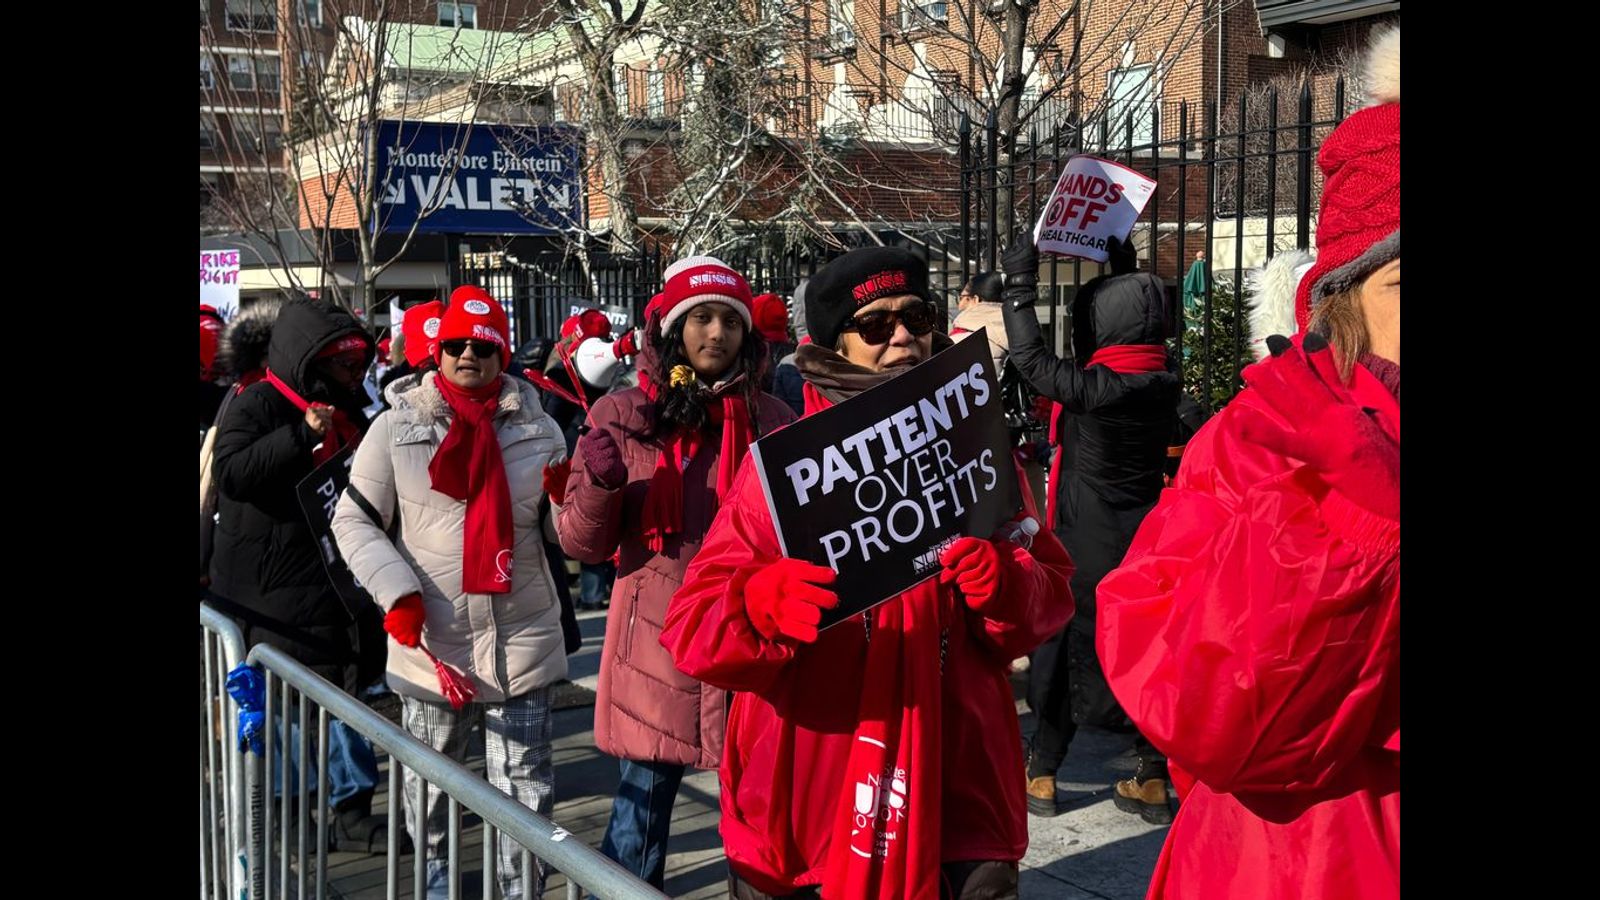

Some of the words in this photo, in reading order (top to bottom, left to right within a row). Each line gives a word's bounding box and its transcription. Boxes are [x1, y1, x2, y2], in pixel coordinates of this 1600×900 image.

[387, 147, 488, 170] Montefiore
[492, 151, 561, 172] Einstein
[411, 175, 541, 211] VALET
[1057, 174, 1125, 204] HANDS
[1046, 196, 1107, 230] OFF
[784, 362, 990, 507] PATIENTS
[855, 438, 958, 512] OVER
[818, 448, 998, 575] PROFITS
